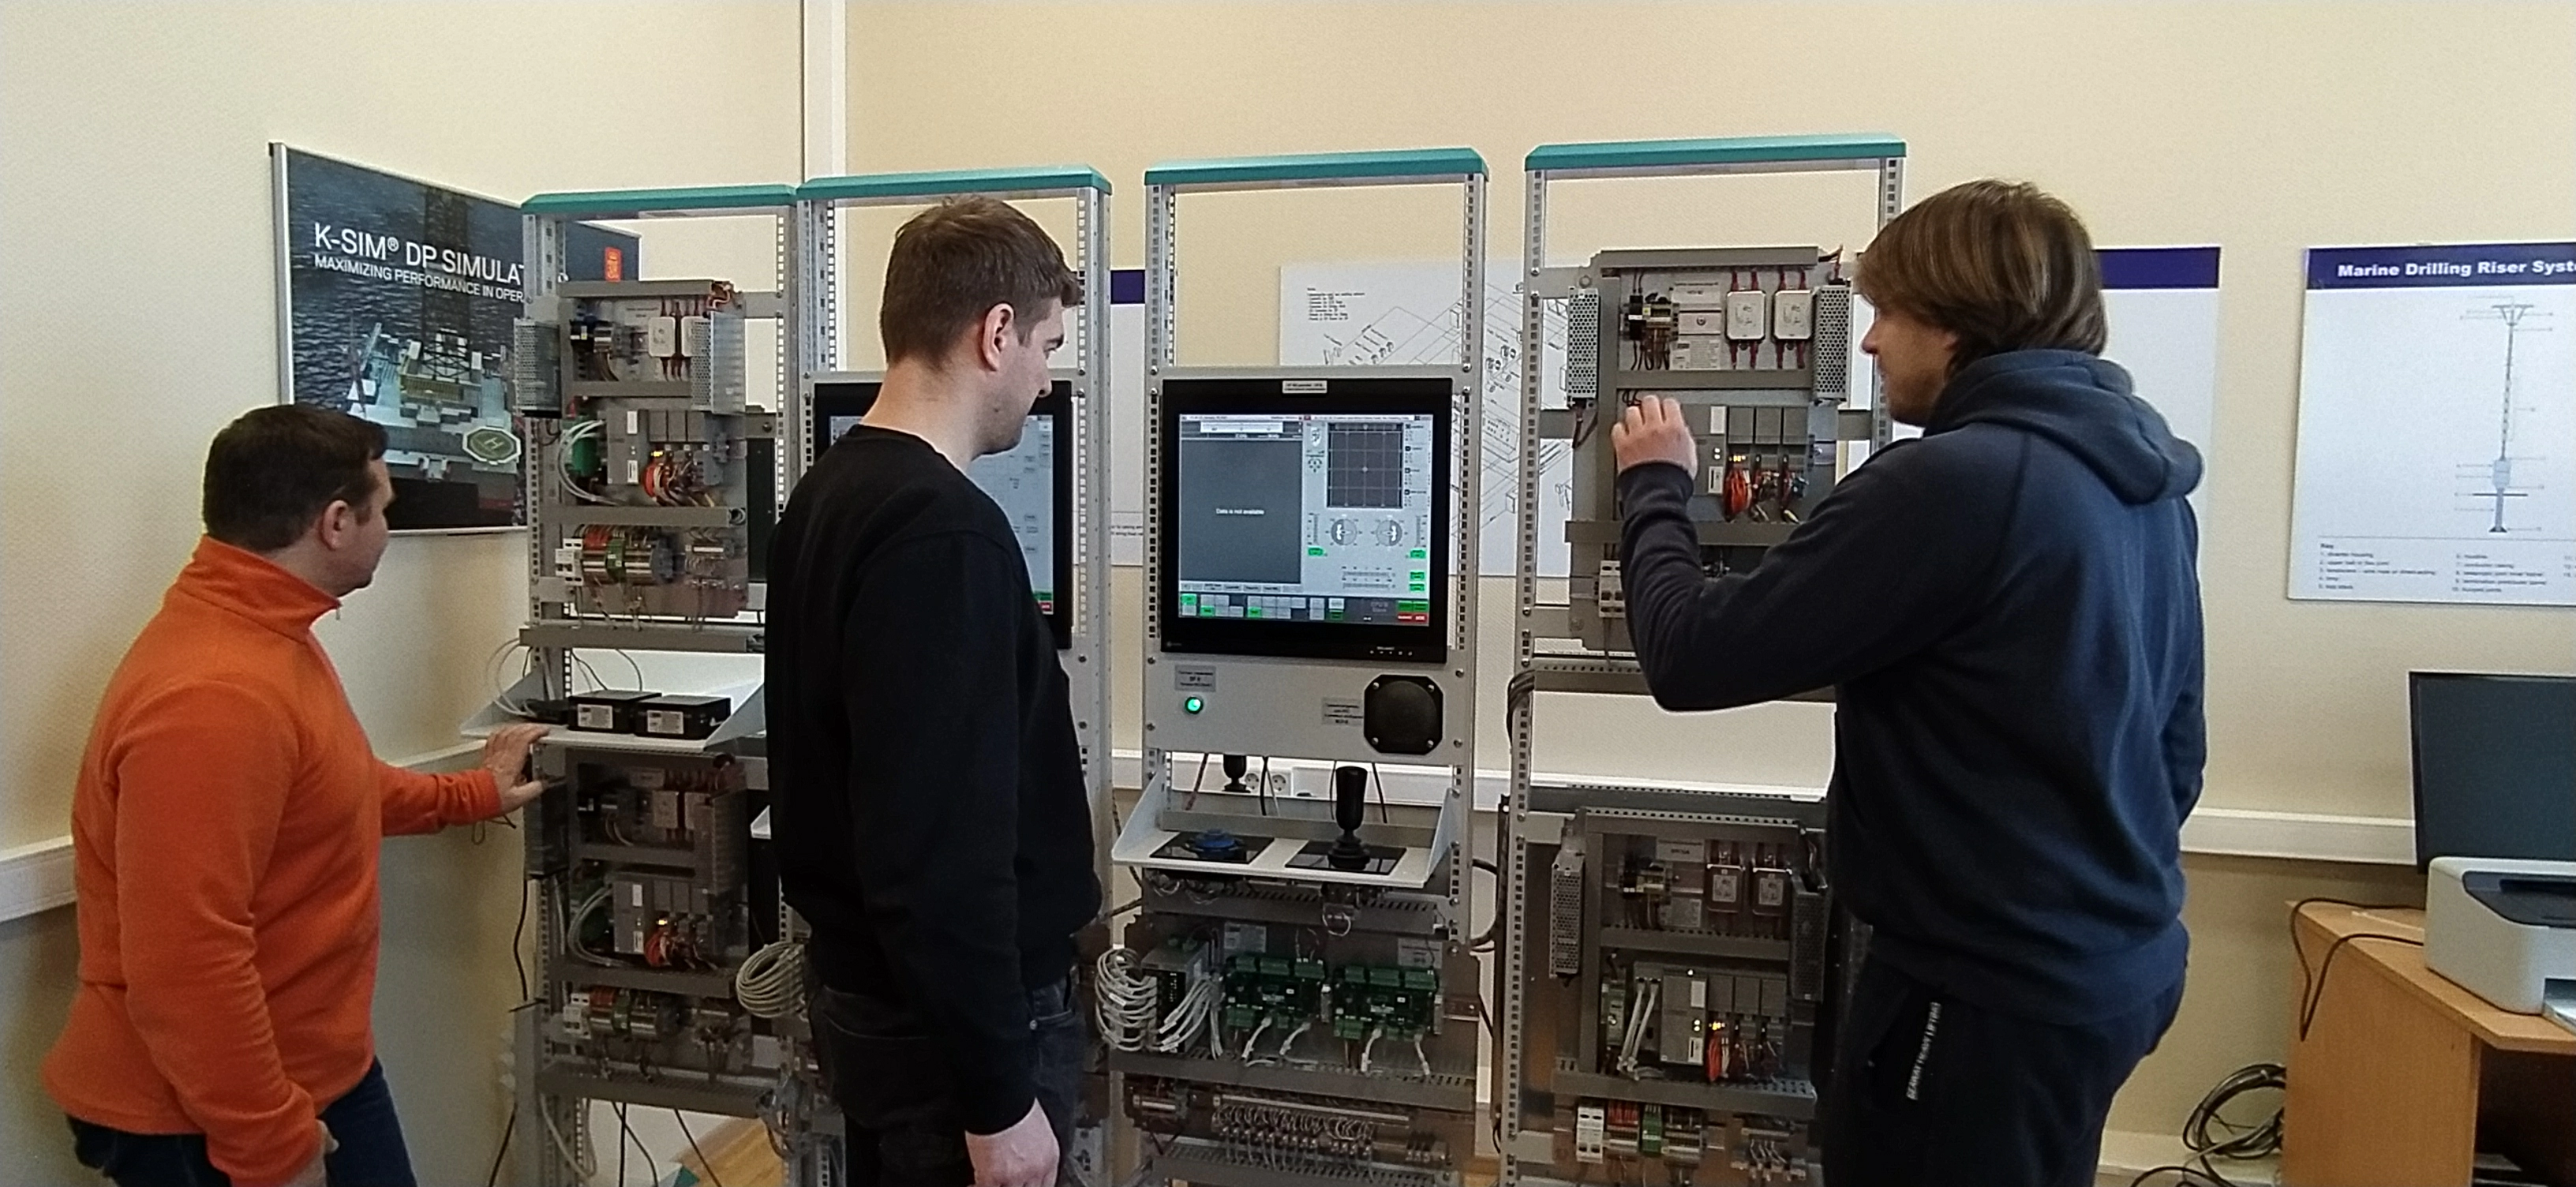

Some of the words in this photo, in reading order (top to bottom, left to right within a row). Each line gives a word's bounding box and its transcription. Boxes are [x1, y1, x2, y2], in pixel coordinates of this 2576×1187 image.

[314, 222, 400, 260] K-SIM®
[406, 242, 437, 268] DP
[314, 253, 393, 281] MAXIMIZING
[395, 269, 480, 296] PERFORMANCE
[482, 286, 495, 298] IN
[2338, 264, 2400, 277] Marine
[2406, 263, 2472, 277] Drilling
[2477, 261, 2527, 275] Riser
[484, 436, 504, 450] H
